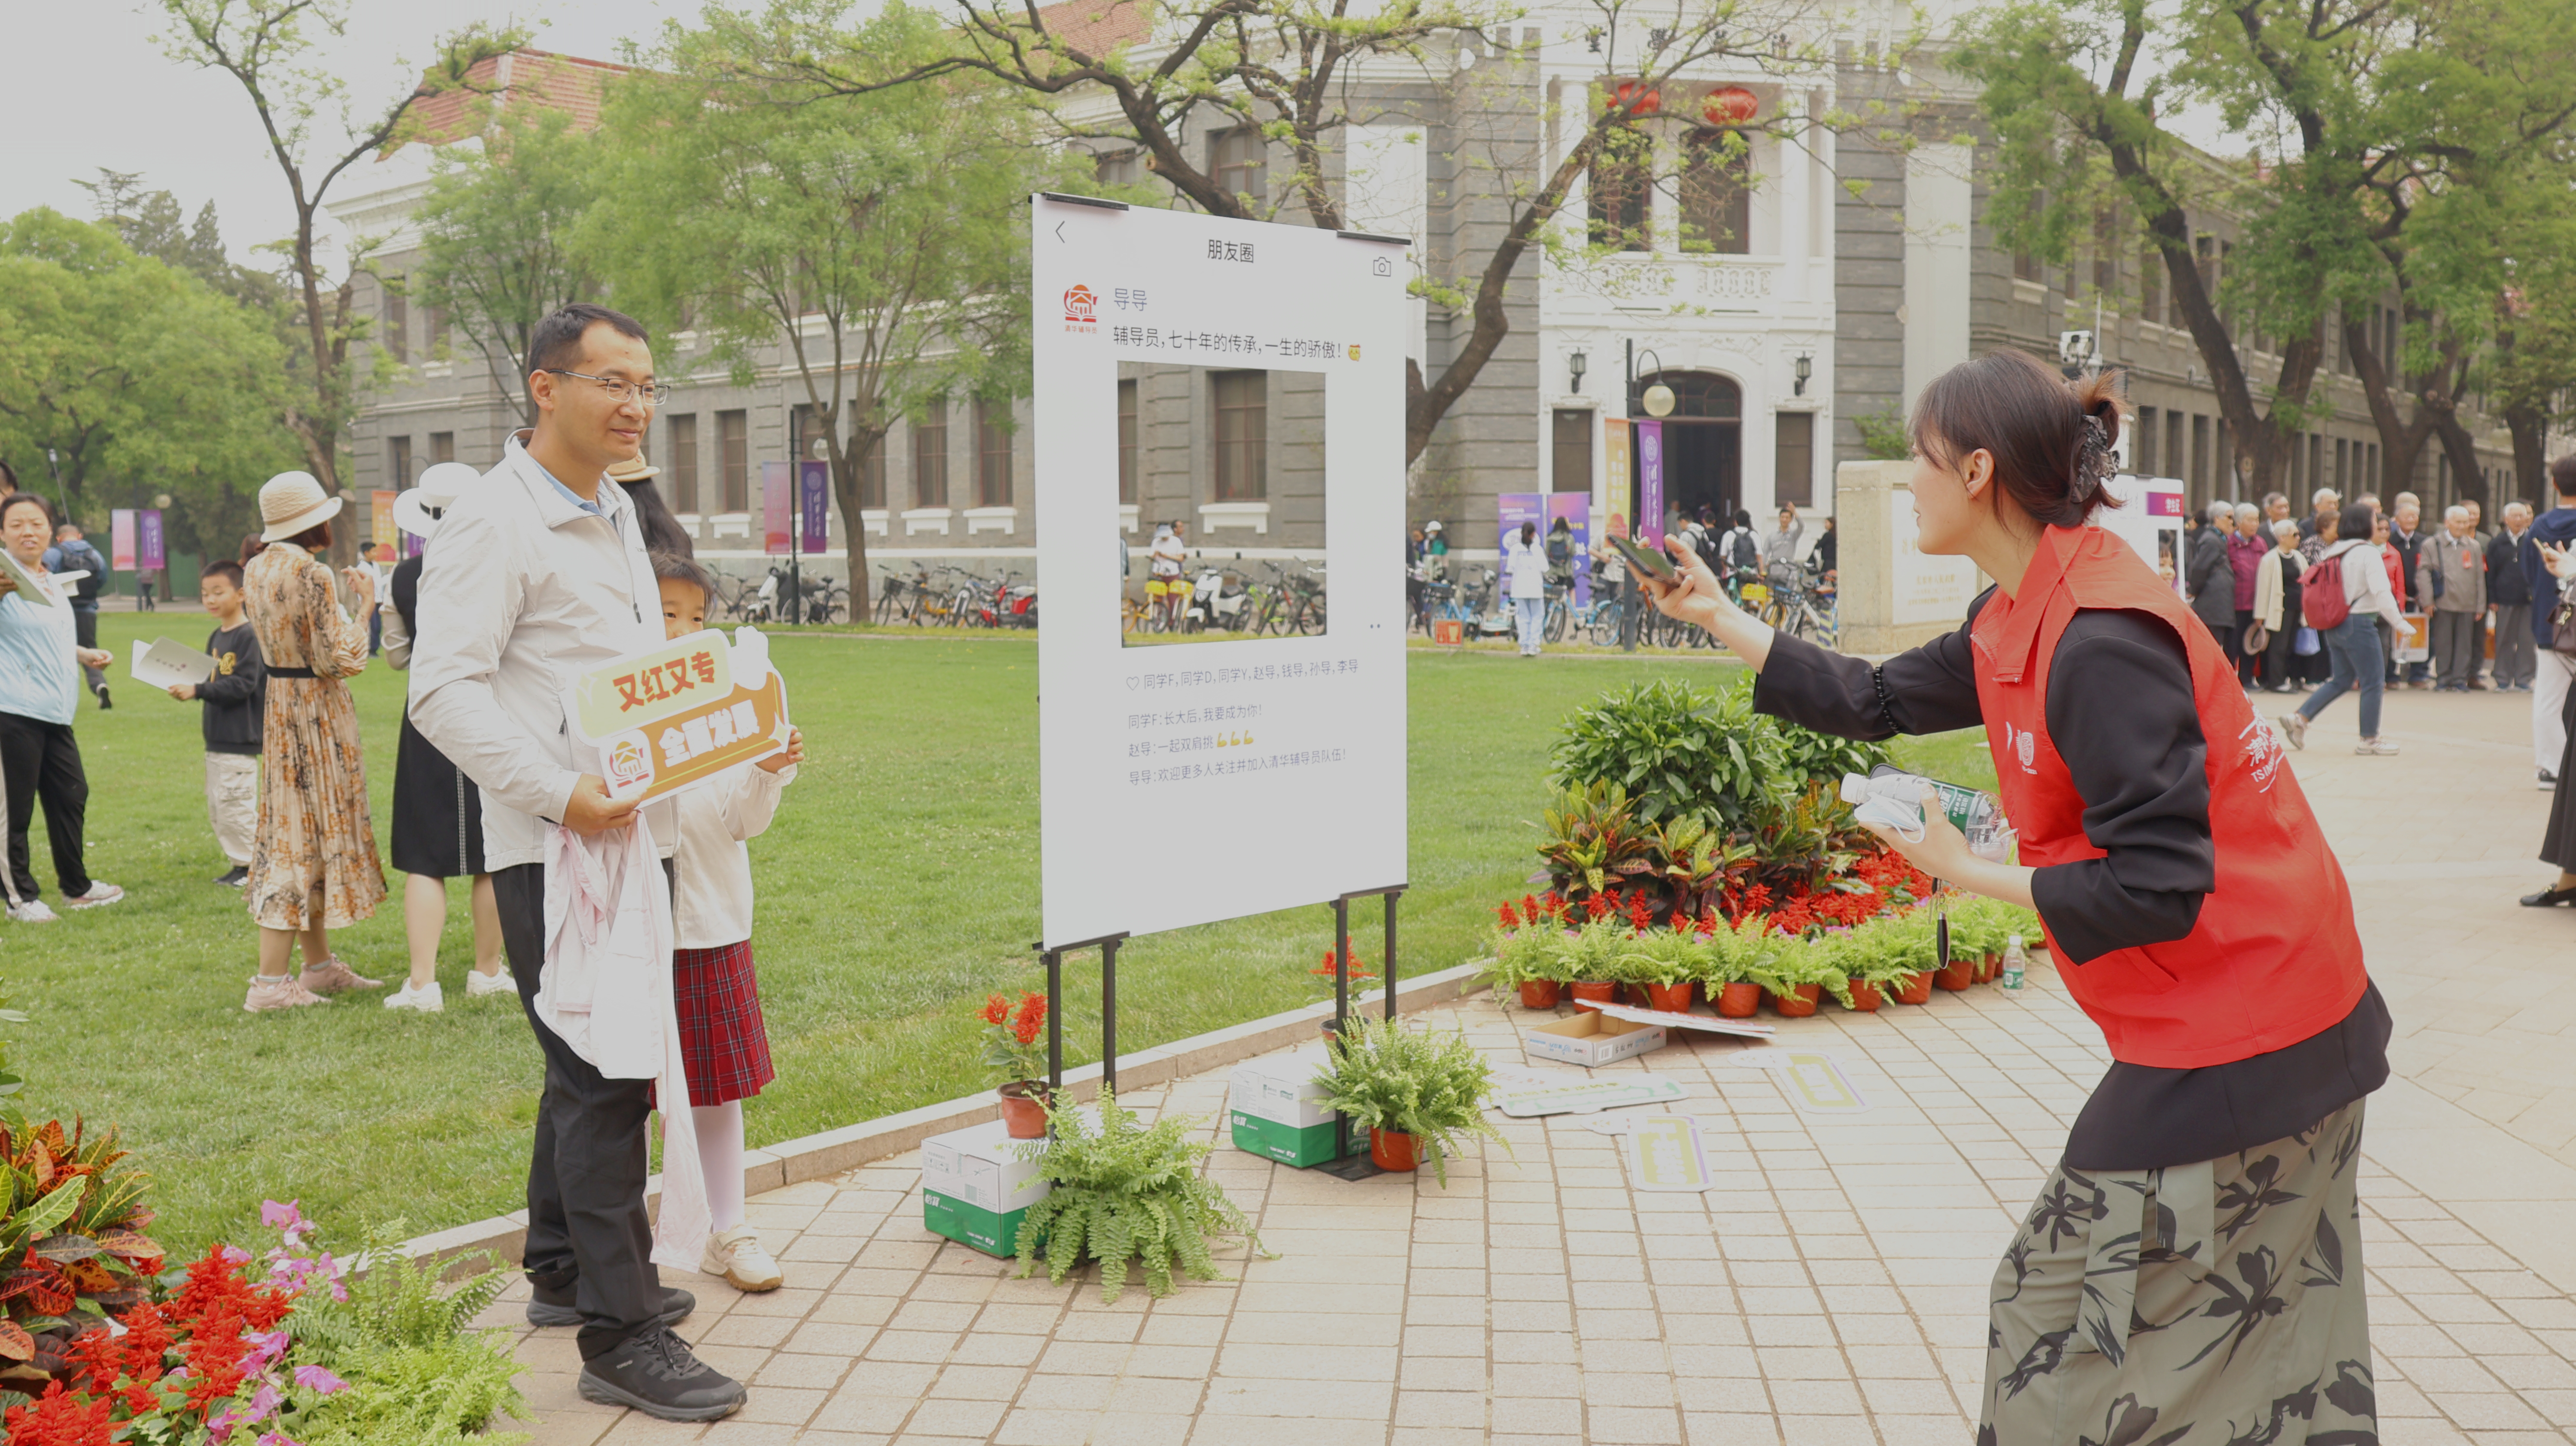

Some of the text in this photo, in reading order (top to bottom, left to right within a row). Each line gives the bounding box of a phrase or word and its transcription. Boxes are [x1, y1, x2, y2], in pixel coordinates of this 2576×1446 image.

[1207, 239, 1254, 263] 朋友圈
[1114, 288, 1148, 312] 导导
[1065, 325, 1097, 334] 清华辅导员
[613, 651, 715, 713] 又红又专
[659, 699, 760, 768] 全面发展
[1129, 735, 1213, 757] 赵导：一起双肩挑
